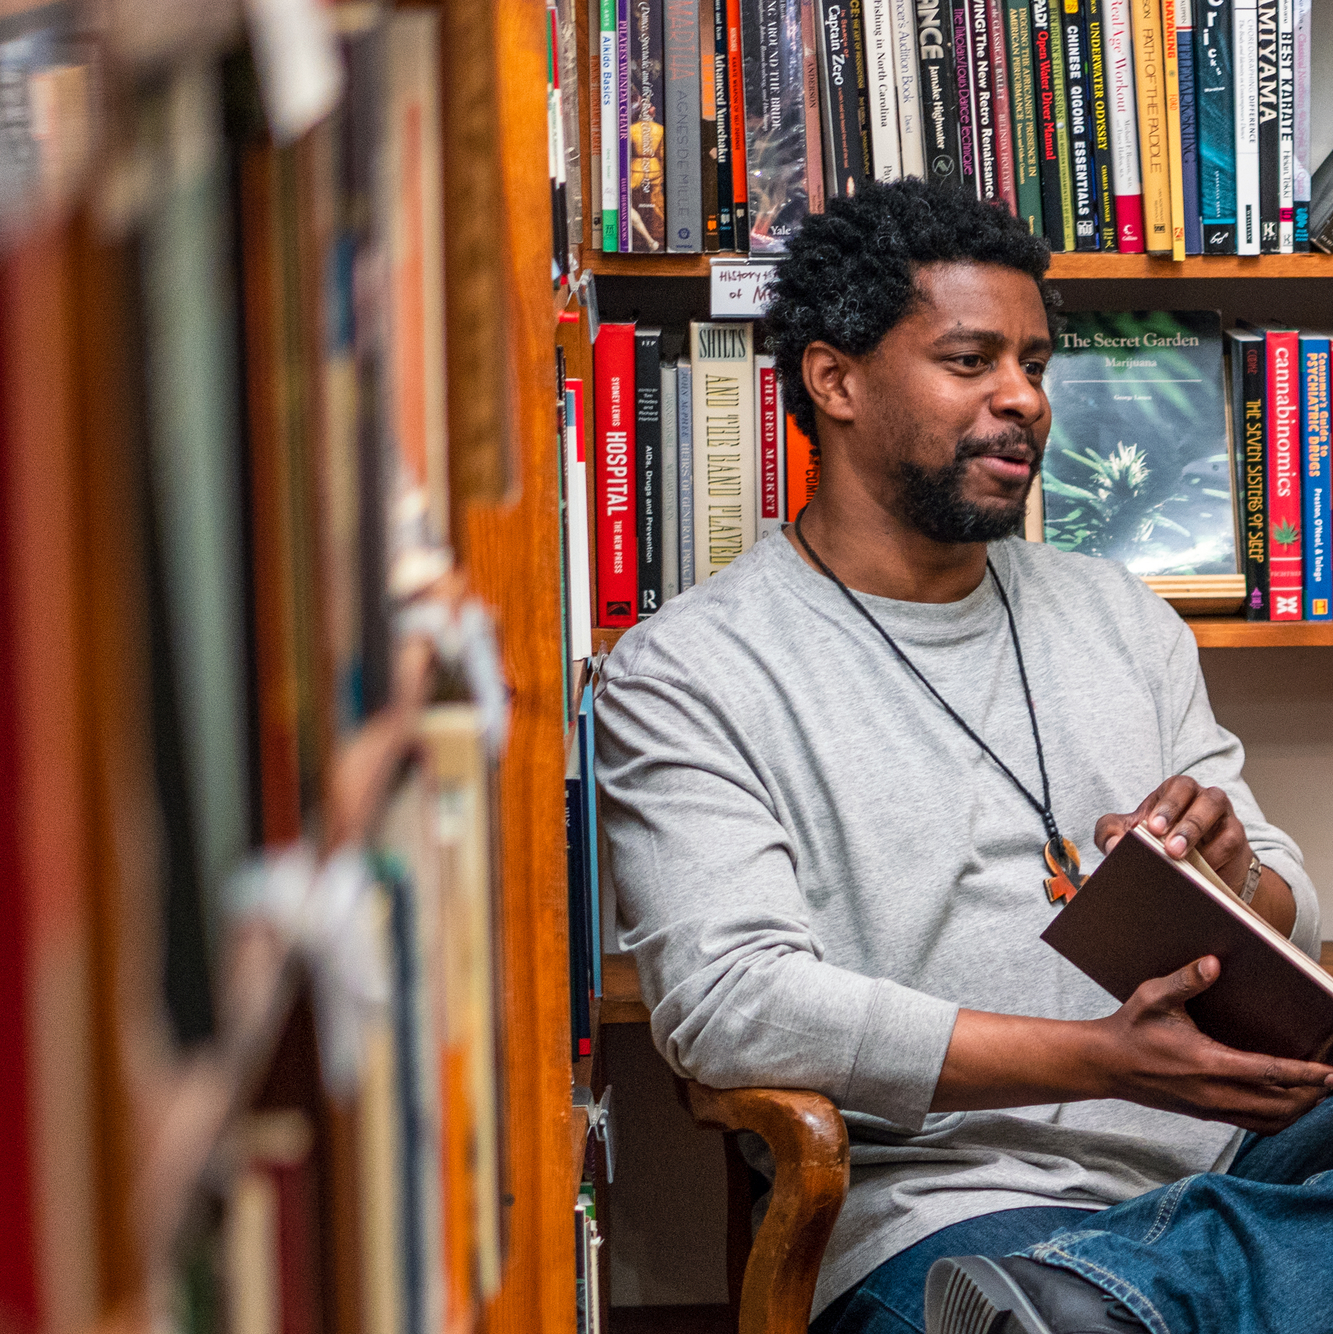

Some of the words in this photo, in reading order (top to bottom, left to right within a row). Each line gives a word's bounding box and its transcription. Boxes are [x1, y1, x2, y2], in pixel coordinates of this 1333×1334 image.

[826, 6, 841, 50] Captain
[1281, 32, 1291, 66] BEST
[602, 37, 611, 67] Aikido
[830, 54, 843, 86] Zero
[1067, 26, 1081, 80] CHINESE
[1090, 23, 1104, 99] UNDERWATER
[602, 71, 611, 106] Basics
[928, 66, 940, 95] Jamake
[930, 98, 945, 150] Highwater
[1070, 87, 1085, 135] QIGONG
[1095, 101, 1107, 150] ODYSSEY
[1281, 68, 1292, 141] KARATE
[1073, 142, 1090, 216] ESSENTIALS
[700, 328, 746, 359] SHILTS
[1060, 333, 1091, 349] The
[1094, 333, 1141, 348] Secret
[1143, 332, 1199, 348] Garden
[1105, 357, 1157, 369] Marijuana
[765, 374, 774, 405] THE
[765, 411, 774, 444] RED
[1276, 347, 1291, 497] cannabinomics
[606, 432, 627, 516] HOSPITAL
[766, 447, 776, 513] MARKET
